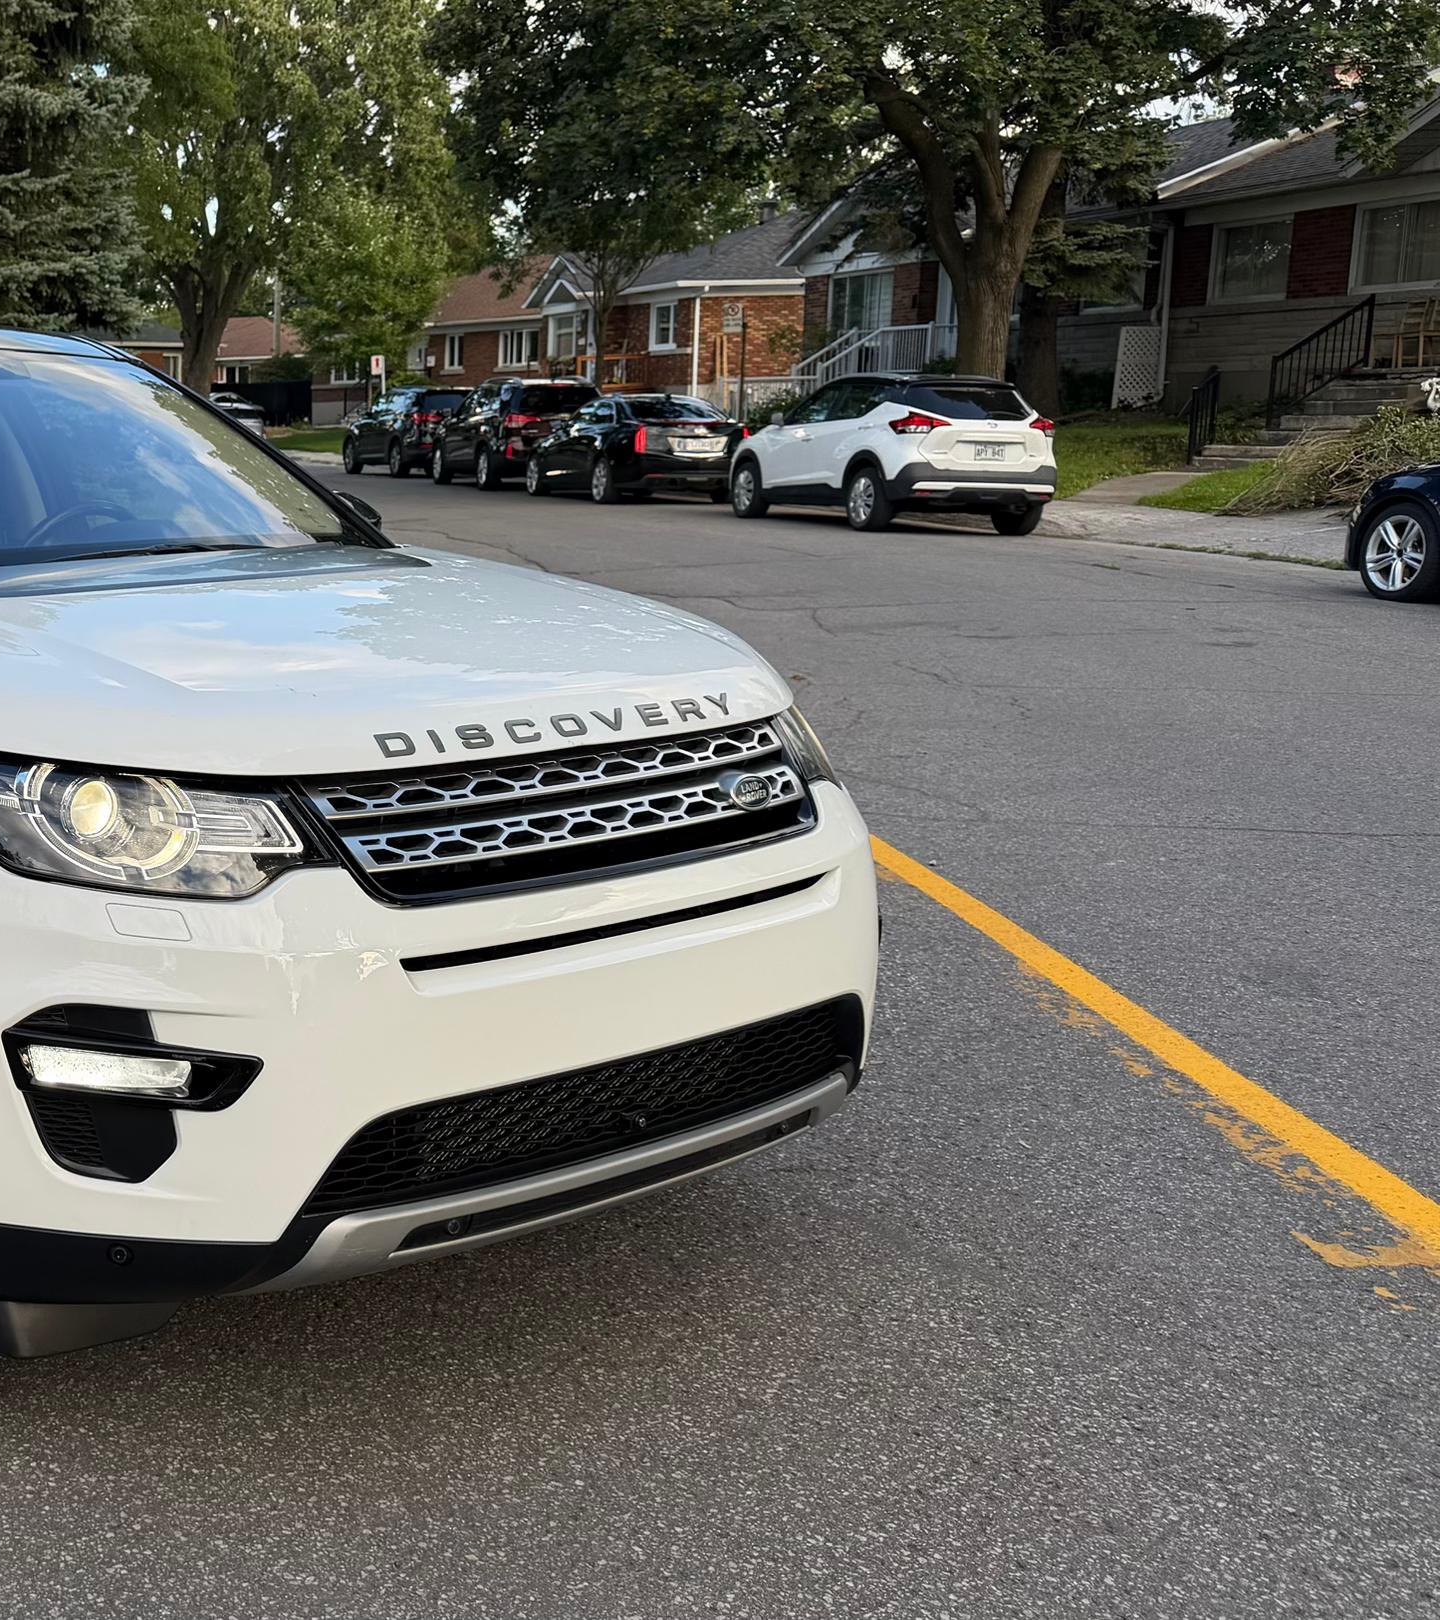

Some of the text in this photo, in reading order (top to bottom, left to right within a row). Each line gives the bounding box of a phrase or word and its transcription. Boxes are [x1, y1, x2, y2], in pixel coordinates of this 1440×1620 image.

[373, 692, 730, 759] DISCOVERY
[740, 781, 759, 793] LAND
[745, 789, 768, 802] ROVER
